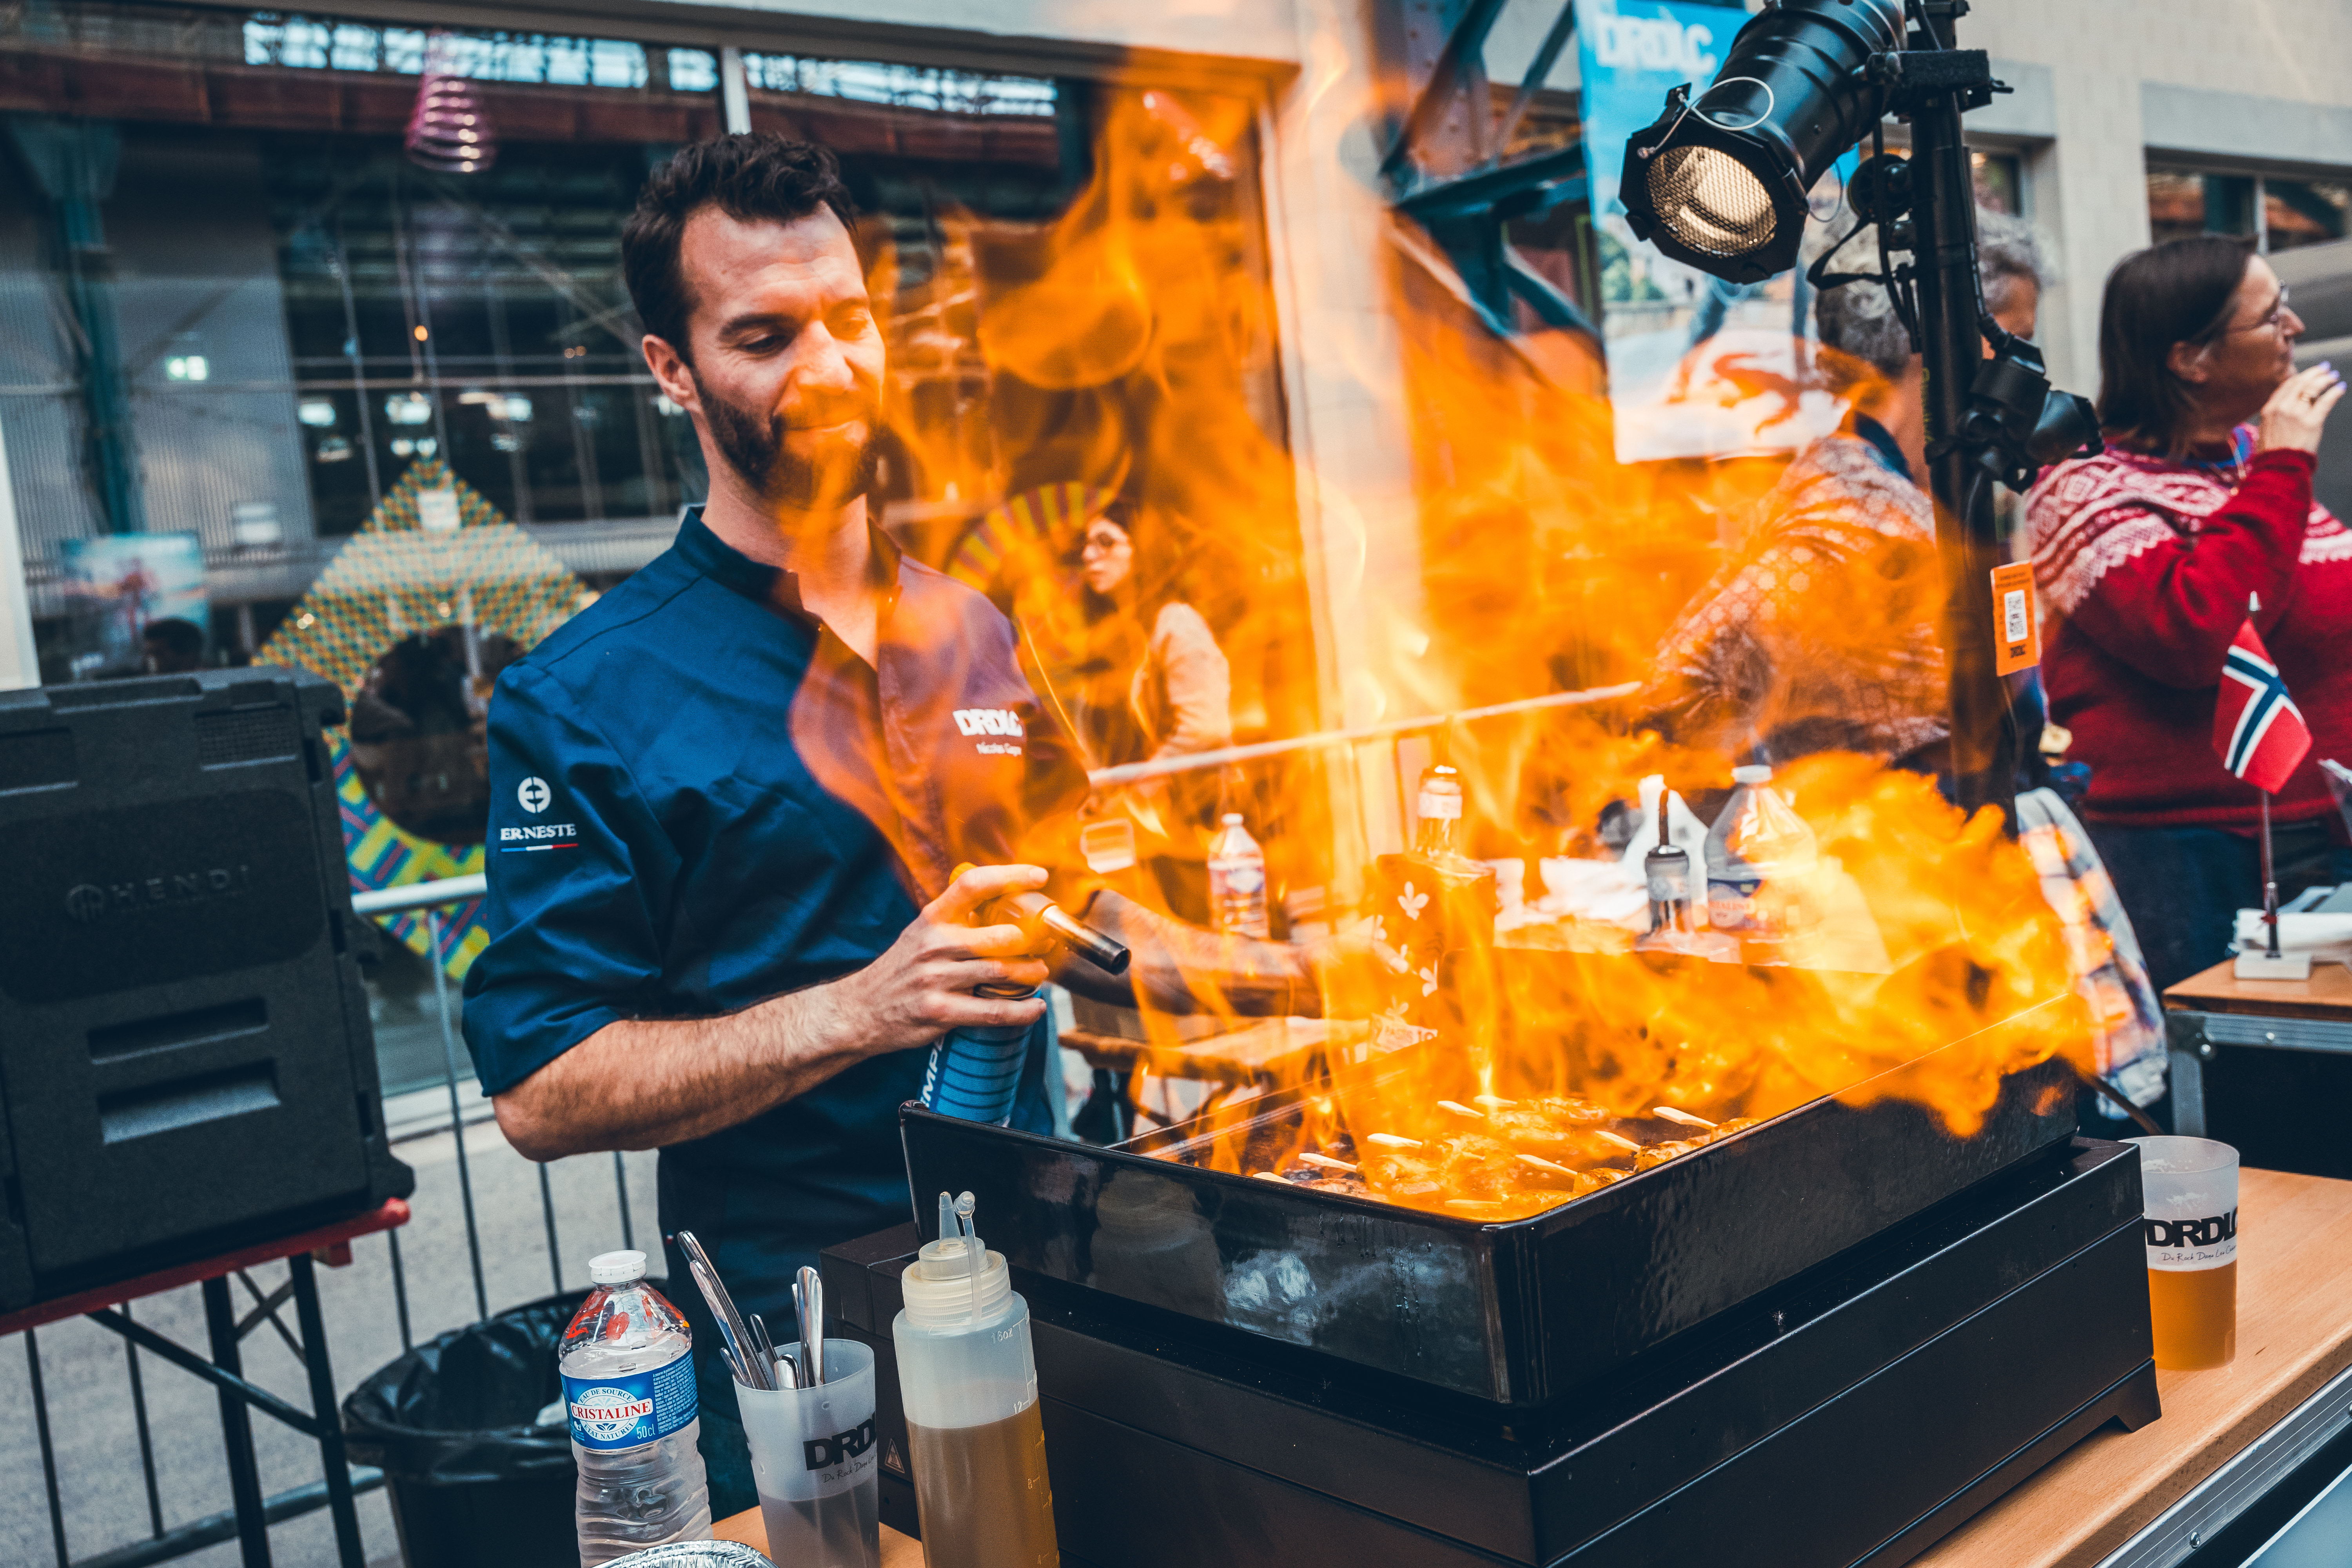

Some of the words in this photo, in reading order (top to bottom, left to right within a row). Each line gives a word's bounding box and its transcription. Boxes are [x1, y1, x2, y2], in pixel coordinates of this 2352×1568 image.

[1595, 15, 1718, 74] DRDLC
[952, 708, 1024, 737] DRDLC
[500, 823, 577, 841] ERNESTE
[991, 1328, 1013, 1344] 16oz
[579, 1392, 590, 1403] EAU
[602, 1388, 633, 1401] SOURCE
[572, 1401, 651, 1420] CRISTALINE
[584, 1424, 599, 1438] ETAT
[600, 1422, 635, 1440] NATUREL
[821, 1473, 835, 1483] Du
[837, 1465, 853, 1480] Rock
